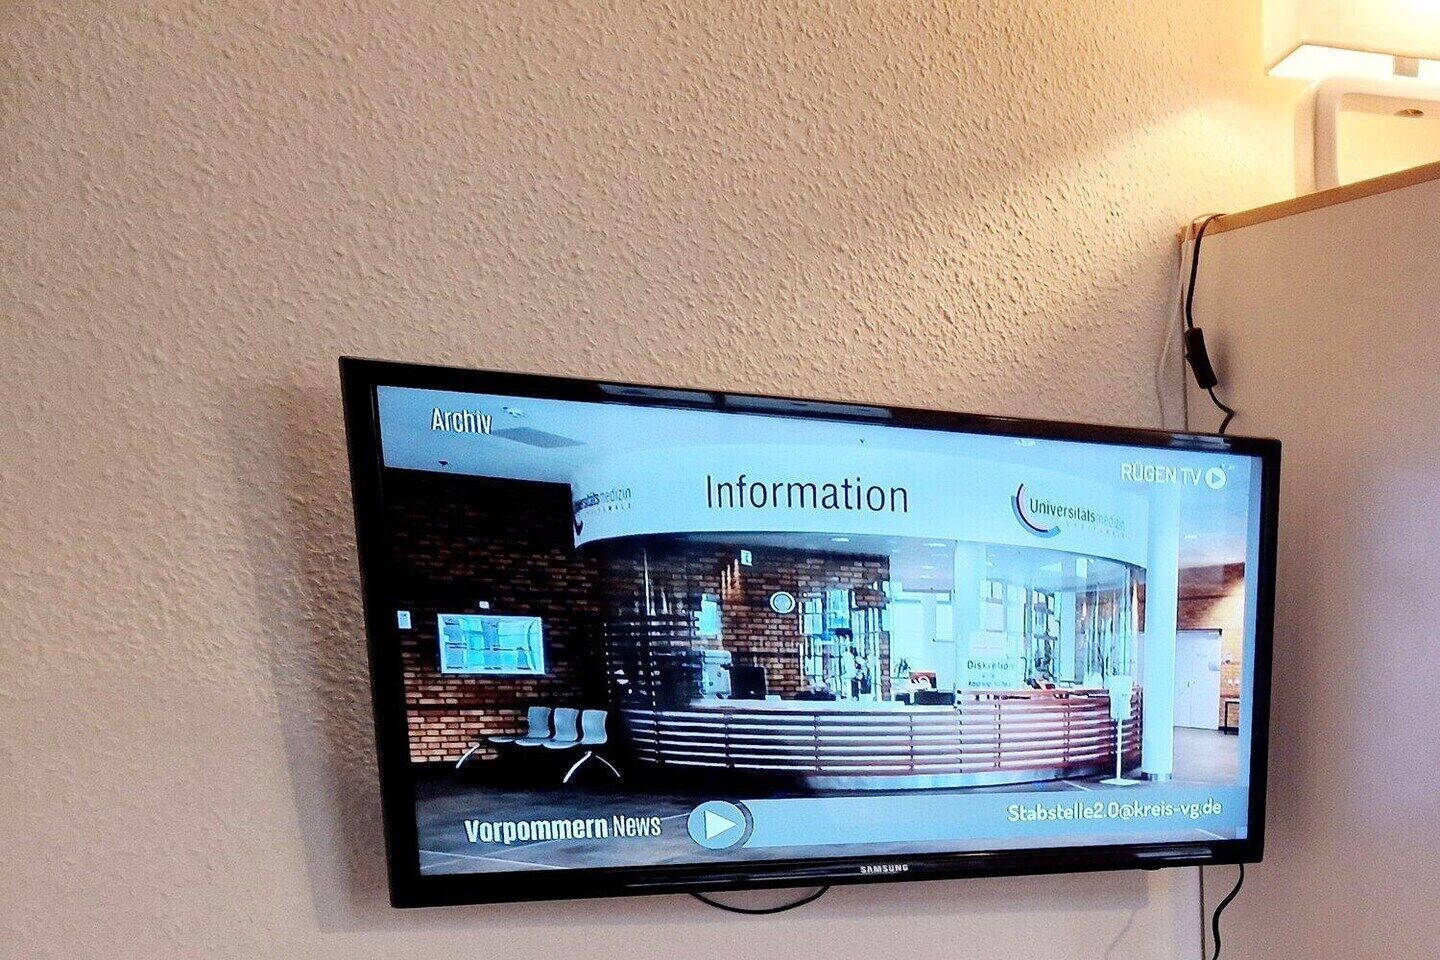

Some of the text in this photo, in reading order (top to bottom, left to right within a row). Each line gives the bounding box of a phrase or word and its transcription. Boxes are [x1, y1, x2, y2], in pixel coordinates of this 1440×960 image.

[431, 406, 493, 435] Archiv
[1120, 460, 1201, 486] RÜGEN TV
[706, 474, 909, 513] Information
[1007, 798, 1223, 822] Stabstelle2.0@kreis-vg.de
[464, 814, 662, 844] Vorpommern News
[860, 864, 909, 875] SAMSUNG
